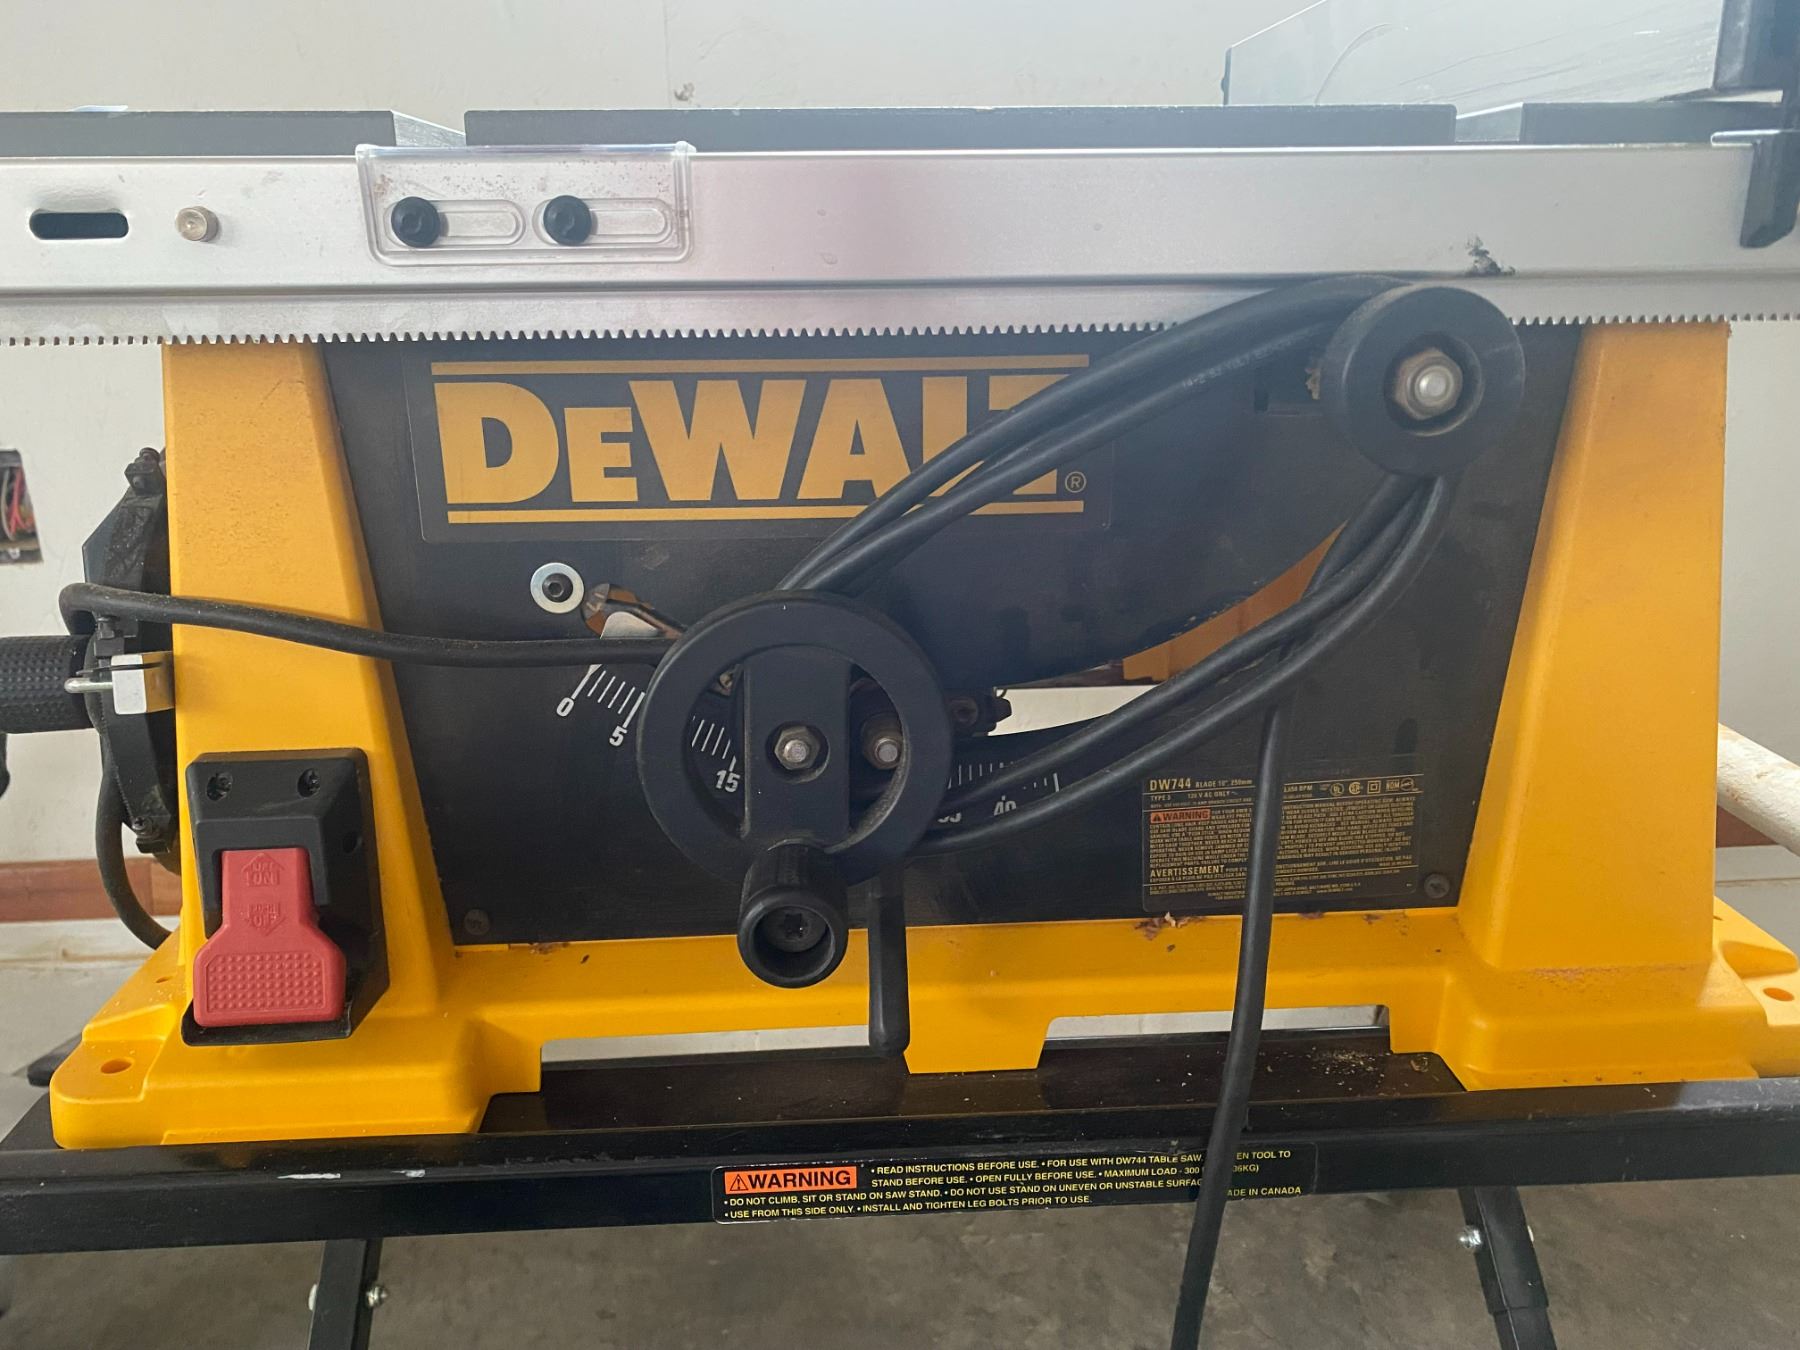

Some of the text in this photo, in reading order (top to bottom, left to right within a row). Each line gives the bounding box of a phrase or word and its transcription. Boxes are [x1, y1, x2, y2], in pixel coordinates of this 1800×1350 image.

[556, 697, 574, 717] 0
[609, 725, 627, 746] 5
[715, 769, 741, 792] 15
[1150, 778, 1191, 791] DW744
[1162, 810, 1209, 821] WARNING
[1150, 864, 1225, 877] AVERTISSEMENT
[877, 1166, 903, 1175] READ
[905, 1163, 975, 1173] INSTRUCTIONS
[977, 1161, 1016, 1170] BEFORE
[1018, 1160, 1039, 1169] USE.
[1047, 1159, 1067, 1168] FOR
[1069, 1158, 1088, 1166] USE
[1090, 1157, 1114, 1166] WITH
[1116, 1156, 1146, 1165] DW744
[1148, 1154, 1178, 1164] TABLE
[1252, 1151, 1276, 1160] TOOL
[1279, 1150, 1291, 1158] TO
[747, 1170, 851, 1189] WARNING
[871, 1179, 903, 1188] STAND
[905, 1177, 944, 1186] BEFORE
[946, 1175, 968, 1184] USE.
[975, 1174, 1002, 1183] OPEN
[1004, 1173, 1033, 1182] FULLY
[1034, 1172, 1073, 1181] BEFORE
[1075, 1170, 1097, 1179] USE.
[1104, 1168, 1149, 1178] MAXIMUM
[1151, 1167, 1177, 1176] LOAD
[1184, 1166, 1200, 1175] 300
[1232, 1164, 1259, 1173] 36KG)
[729, 1198, 744, 1206] DO
[746, 1197, 765, 1205] NOT
[802, 1194, 817, 1203] SIT
[819, 1194, 833, 1202] OR
[835, 1192, 867, 1201] STAND
[869, 1192, 883, 1200] ON
[885, 1190, 907, 1199] SAW
[908, 1189, 943, 1199] STAND.
[950, 1188, 964, 1196] DO
[967, 1187, 986, 1196] NOT
[988, 1186, 1007, 1195] USE
[1009, 1185, 1040, 1194] STAND
[1043, 1184, 1057, 1193] ON
[1059, 1183, 1097, 1192] UNEVEN
[1099, 1182, 1113, 1190] OR
[1115, 1180, 1164, 1190] UNSTABLE
[1227, 1186, 1302, 1197] ADE IN CANADA
[730, 1195, 1093, 1219] USE FROM THIS SIDE ONLY. INSTALL AND TIGHTEN LEG BOLTS PRIOR TO USE.
